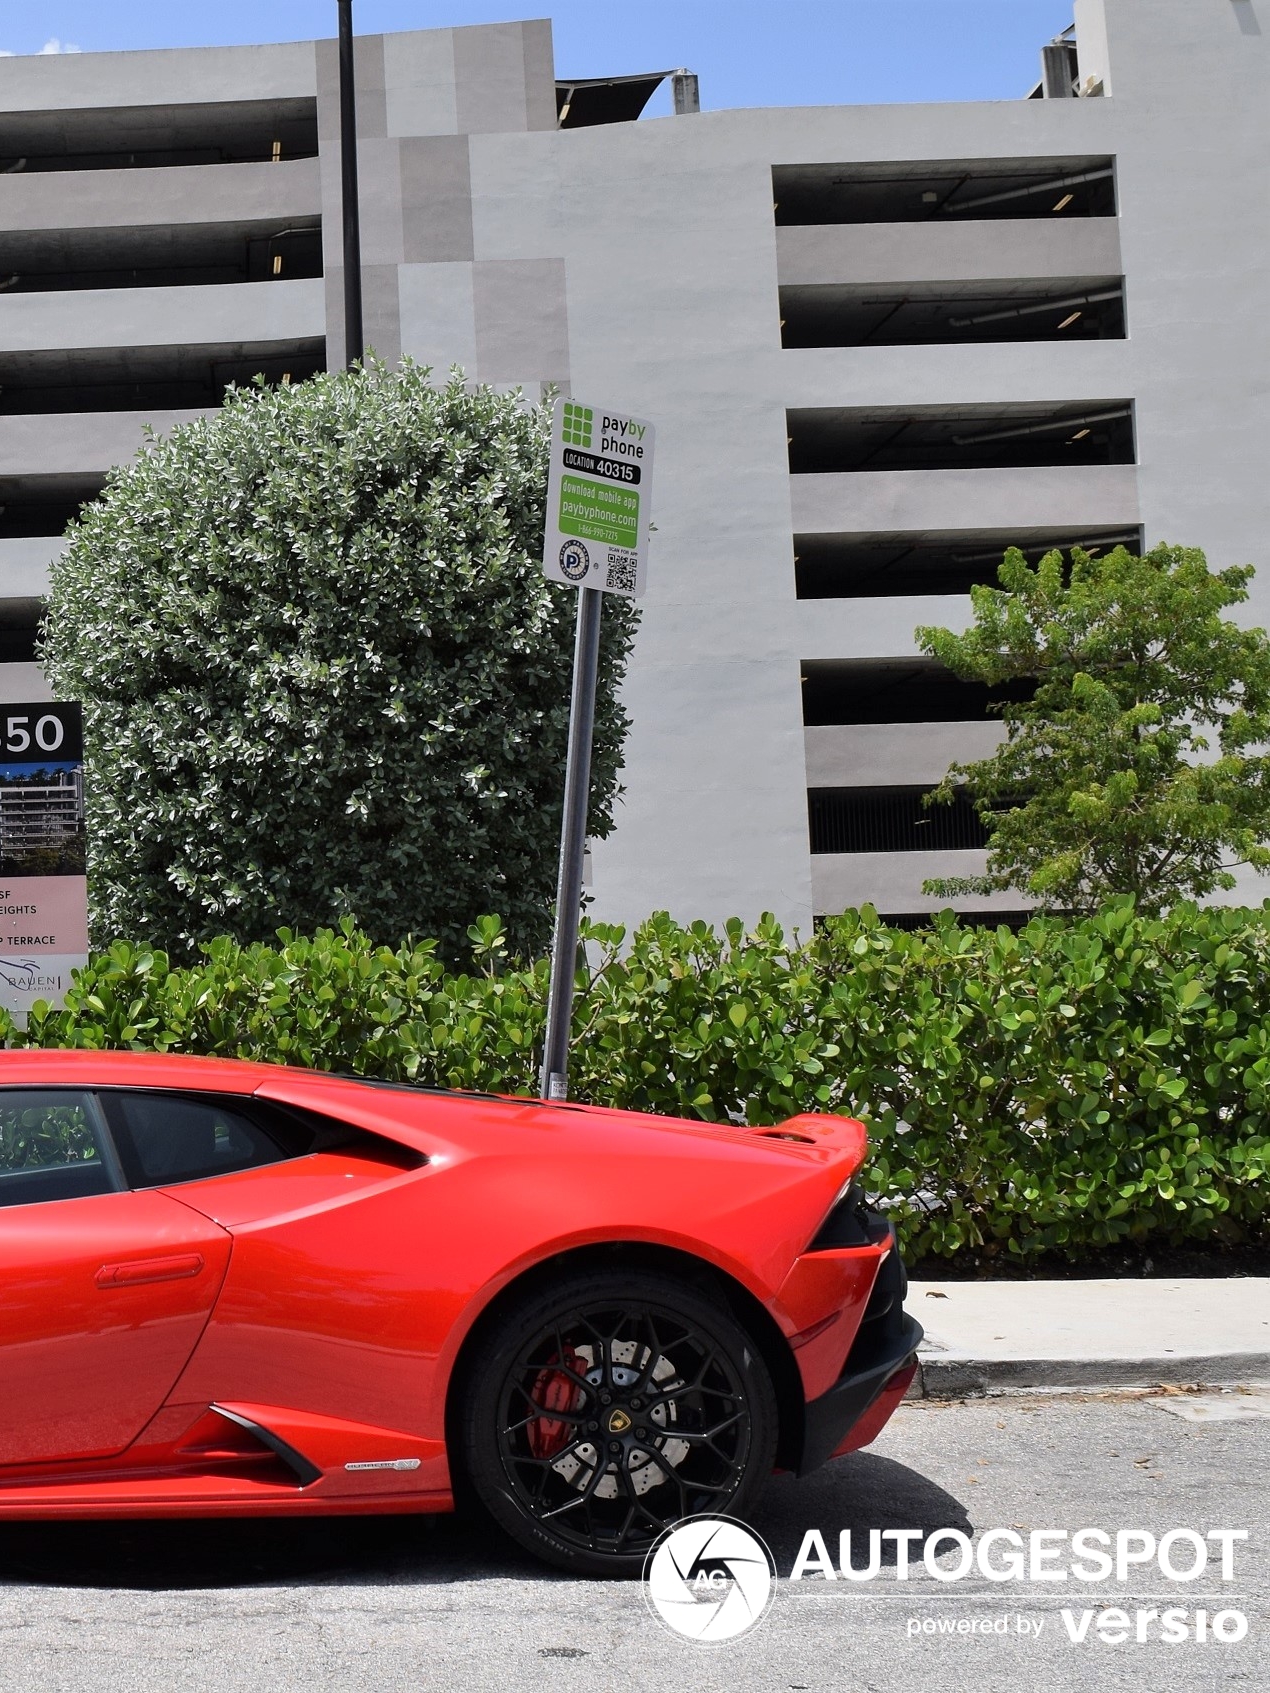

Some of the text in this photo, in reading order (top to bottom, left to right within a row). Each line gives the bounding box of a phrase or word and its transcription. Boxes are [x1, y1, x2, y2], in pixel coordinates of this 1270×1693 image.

[602, 416, 646, 441] payby
[601, 436, 644, 458] phone
[565, 452, 634, 480] LOCATION 40315
[562, 480, 637, 510] download mobile app
[562, 501, 636, 527] paybyphone.com
[578, 524, 618, 541] 1-866-990-7275
[7, 935, 56, 945] TERRACE
[8, 976, 55, 986] BAUEN
